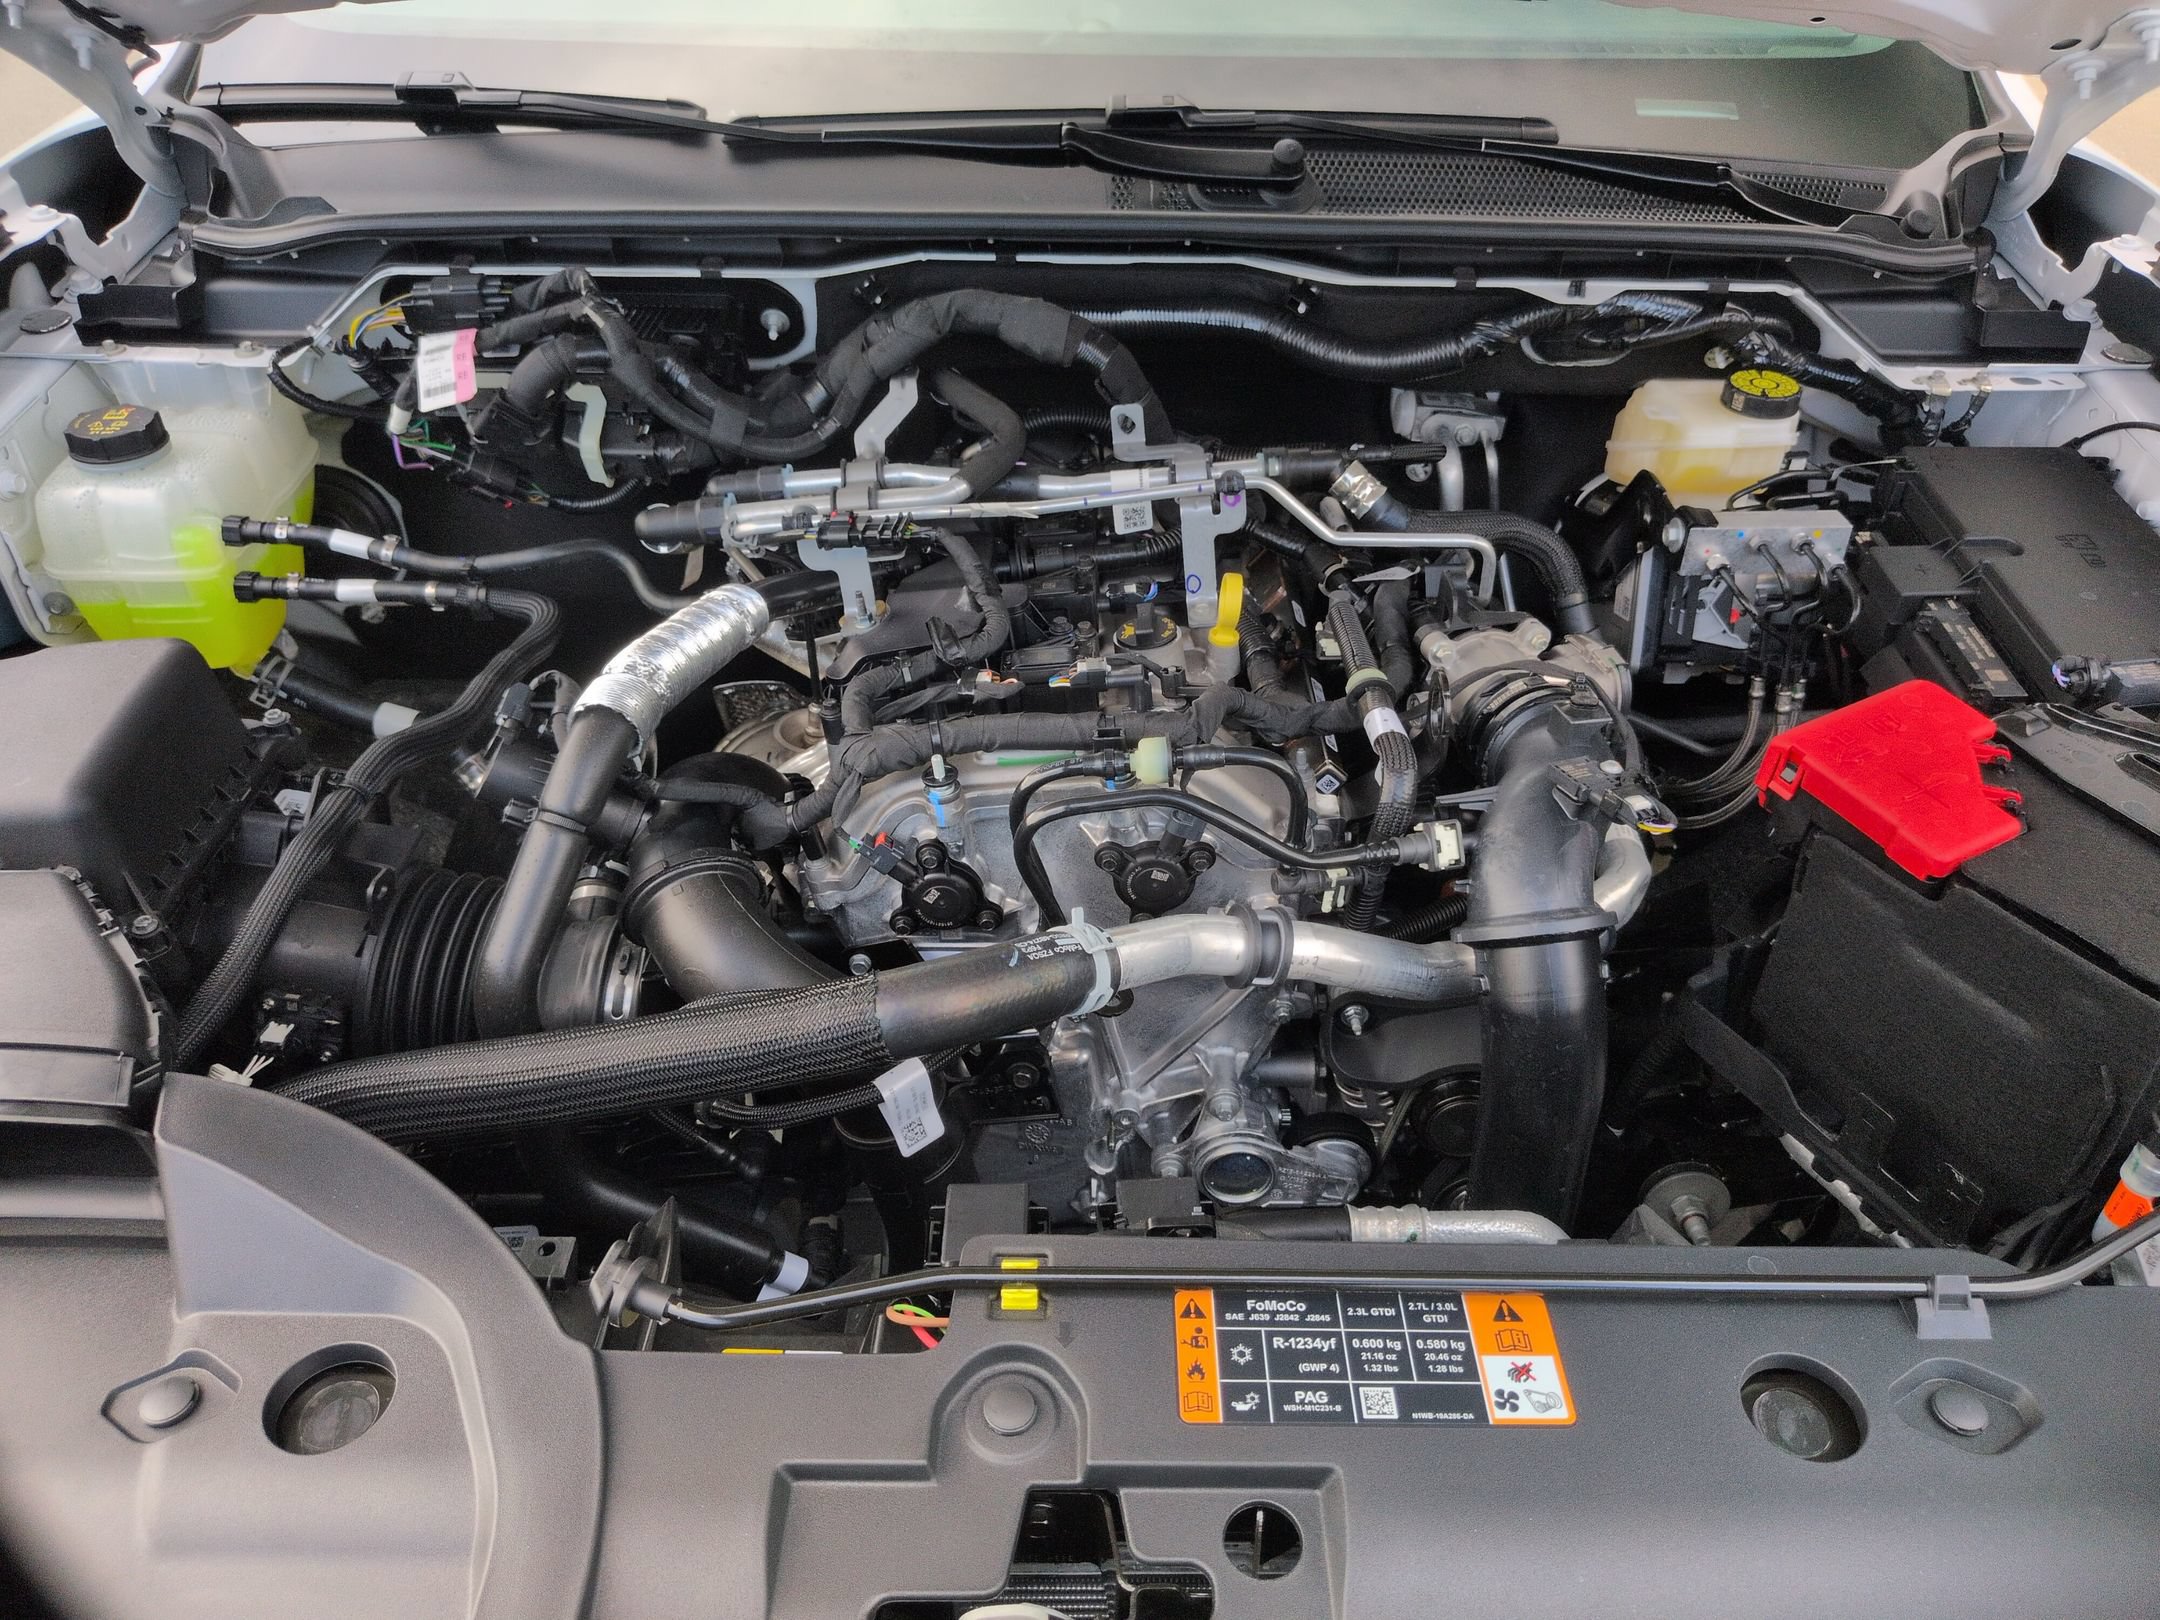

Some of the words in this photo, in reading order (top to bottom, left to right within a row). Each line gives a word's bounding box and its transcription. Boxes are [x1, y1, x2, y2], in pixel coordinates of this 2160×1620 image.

[1246, 1299, 1307, 1312] FoMoCo
[1407, 1302, 1430, 1311] 2.7L
[1436, 1302, 1458, 1311] 3.0L
[1346, 1307, 1369, 1316] 2.3L
[1370, 1307, 1396, 1316] GTDI
[1225, 1313, 1245, 1321] SAE
[1248, 1313, 1270, 1321] J639
[1274, 1314, 1300, 1322] J2842
[1305, 1314, 1331, 1322] J2845
[1422, 1314, 1448, 1323] GTDI
[1272, 1336, 1337, 1352] R-1234yf
[1352, 1338, 1384, 1349] 0.600
[1386, 1338, 1402, 1351] kg
[1416, 1339, 1448, 1349] 0.580
[1450, 1339, 1466, 1352] kg
[1360, 1352, 1384, 1361] 21.16
[1385, 1353, 1397, 1361] oz
[1424, 1352, 1449, 1361] 20.46
[1298, 1362, 1327, 1374] (GWP
[1329, 1363, 1340, 1374] 4)
[1363, 1364, 1383, 1372] 1.32
[1384, 1364, 1399, 1372] lbs
[1427, 1364, 1448, 1373] 1.28
[1449, 1365, 1464, 1373] lbs
[1294, 1391, 1329, 1404] PAG
